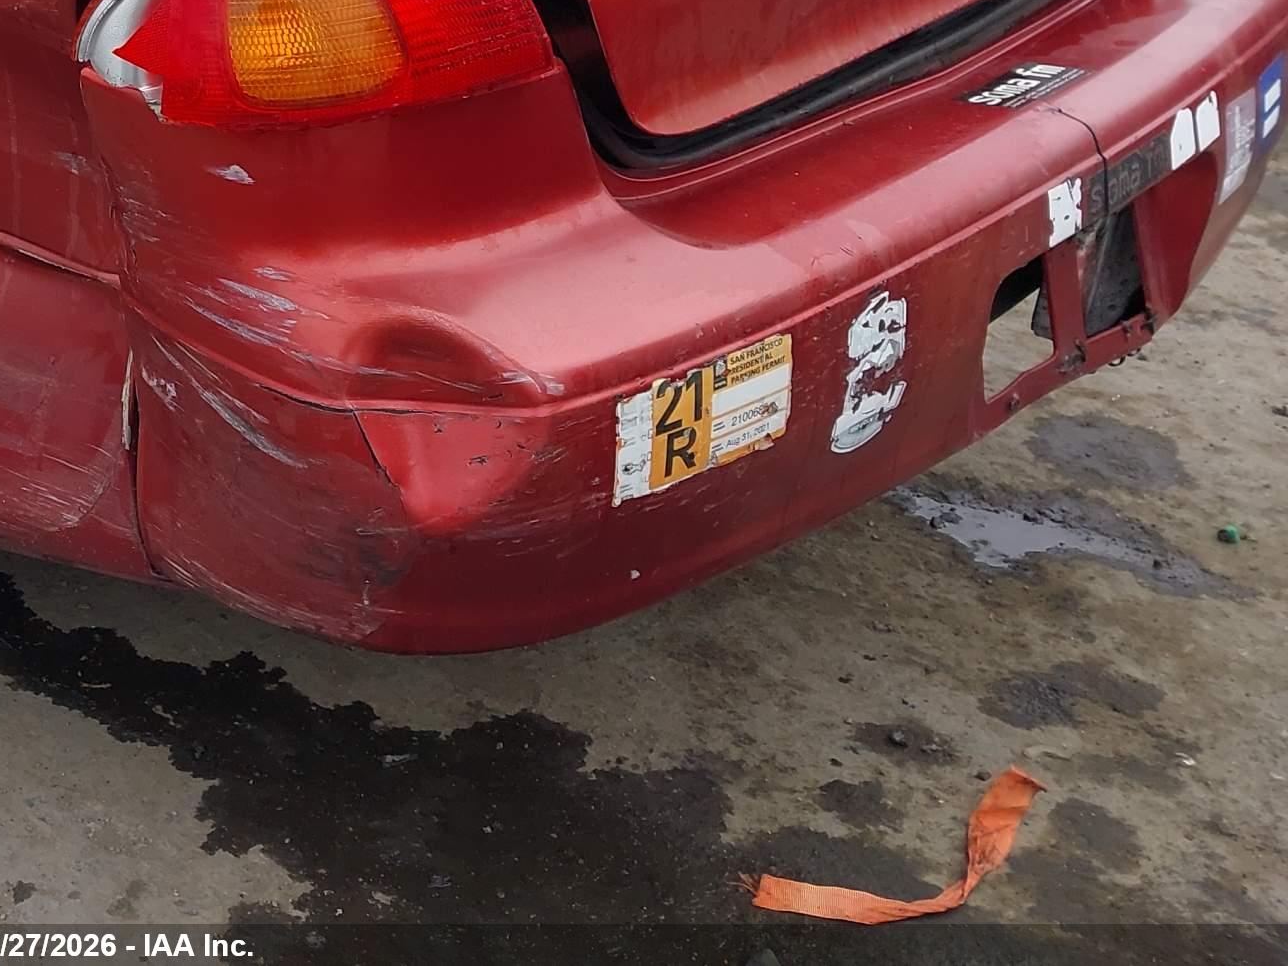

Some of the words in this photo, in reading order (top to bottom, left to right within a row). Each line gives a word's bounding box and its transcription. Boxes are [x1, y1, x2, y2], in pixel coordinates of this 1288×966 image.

[968, 78, 1041, 106] soma
[1015, 64, 1066, 78] fm
[730, 353, 745, 365] SAN
[746, 338, 783, 358] FRANCISCO
[731, 352, 773, 374] RESIDENTAL
[731, 367, 761, 384] PARKING
[762, 355, 786, 372] PERMIT
[656, 371, 703, 437] 21
[664, 426, 697, 478] R
[726, 437, 740, 447] Aug
